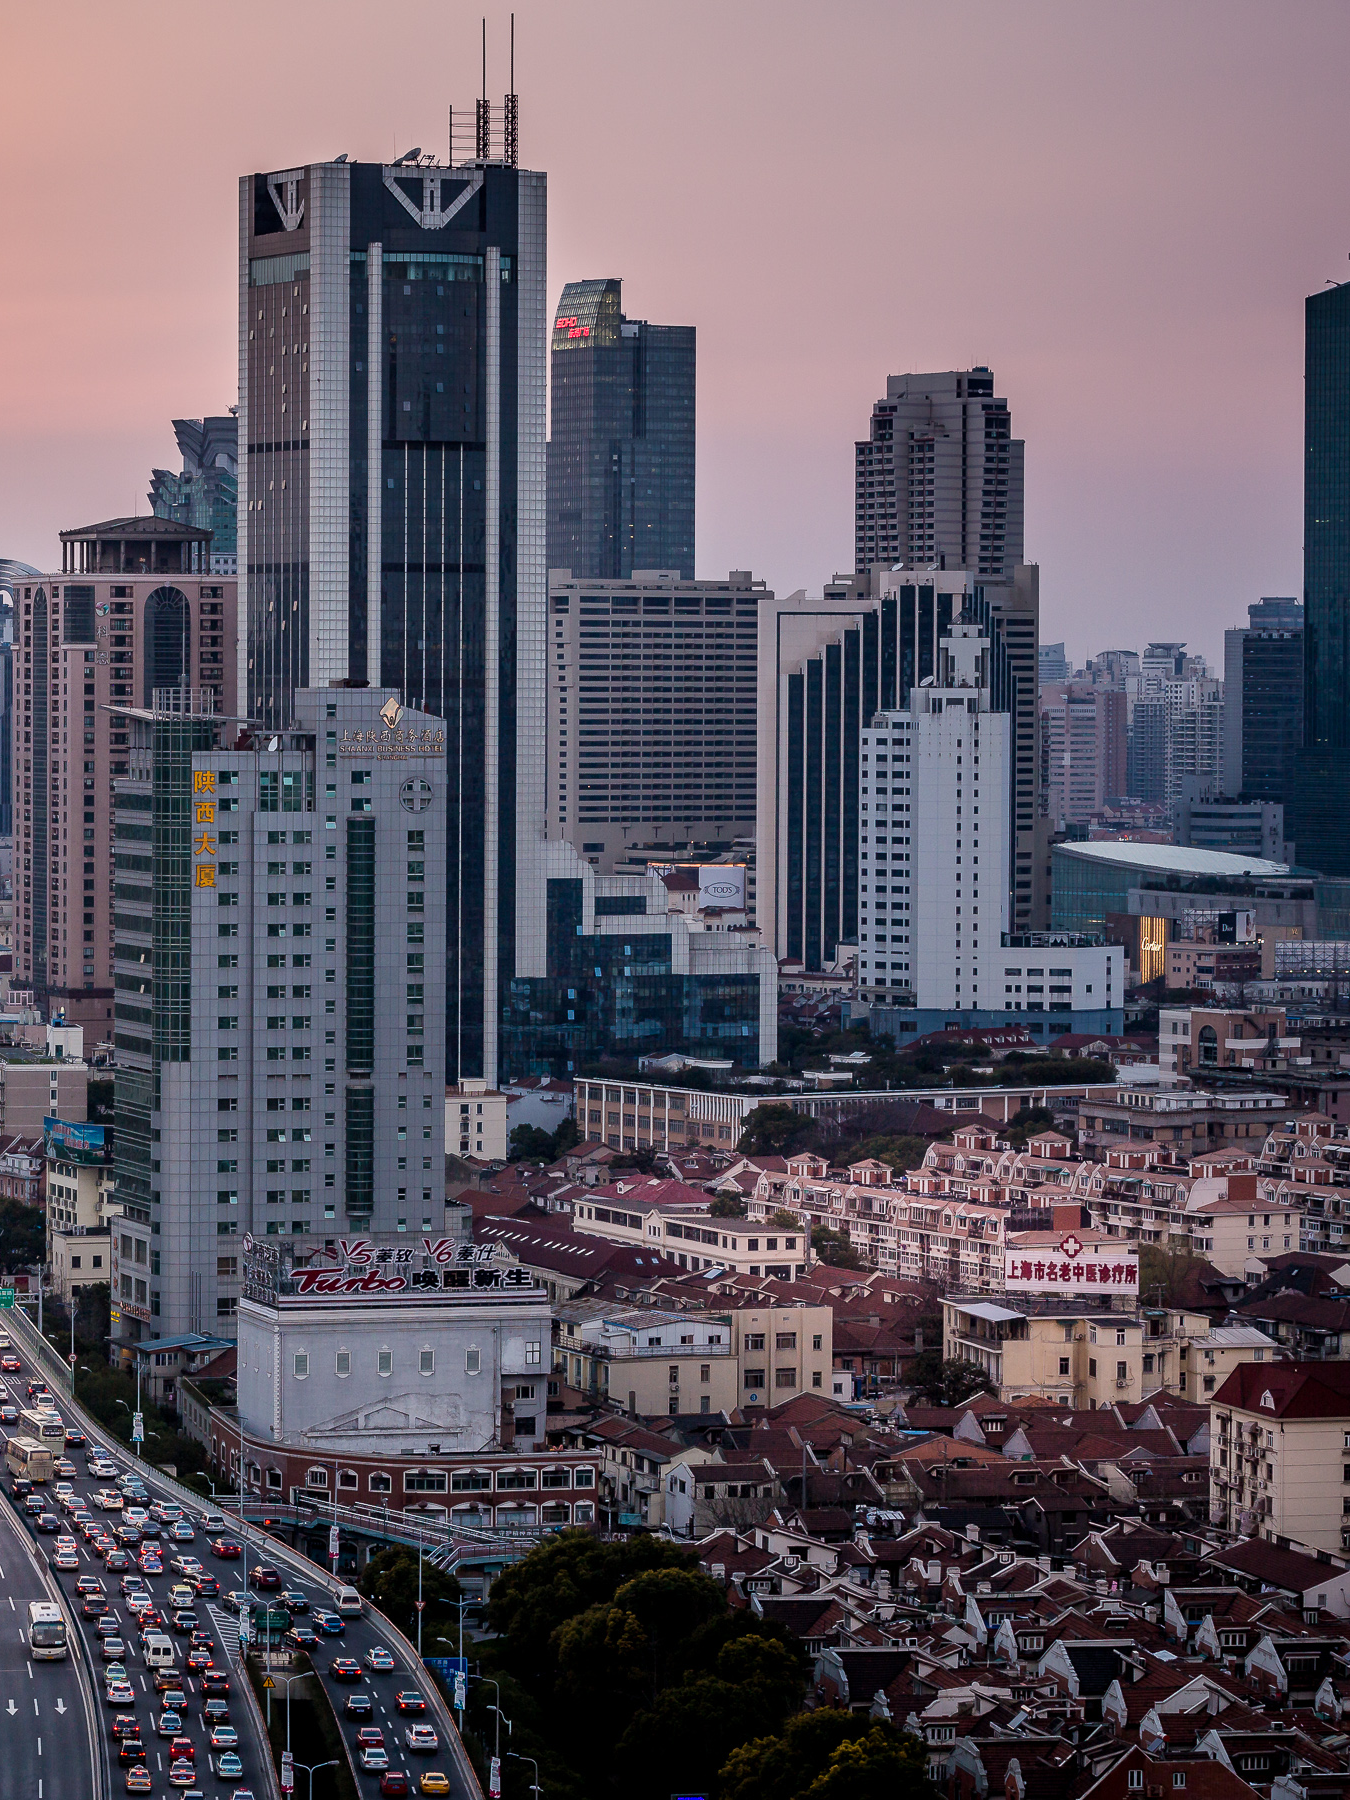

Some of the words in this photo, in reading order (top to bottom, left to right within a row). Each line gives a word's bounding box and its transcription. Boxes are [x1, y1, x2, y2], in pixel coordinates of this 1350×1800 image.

[556, 316, 578, 328] SOHO
[340, 728, 445, 743] 上海陕西商务酒店
[339, 745, 375, 753] SHAANXI
[377, 745, 416, 753] BUSINESS
[418, 745, 444, 753] HOTEL
[194, 770, 217, 888] 陕西大厦
[1222, 923, 1234, 932] Dior
[1141, 936, 1163, 952] Cartier
[339, 1239, 376, 1265] V5
[375, 1248, 413, 1264] 菱致
[421, 1237, 457, 1265] V6
[455, 1244, 496, 1263] 菱仕
[1007, 1259, 1138, 1284] 上海市名老中医诊疗所
[290, 1267, 407, 1294] Turbo
[411, 1267, 534, 1290] 唤醒新生
